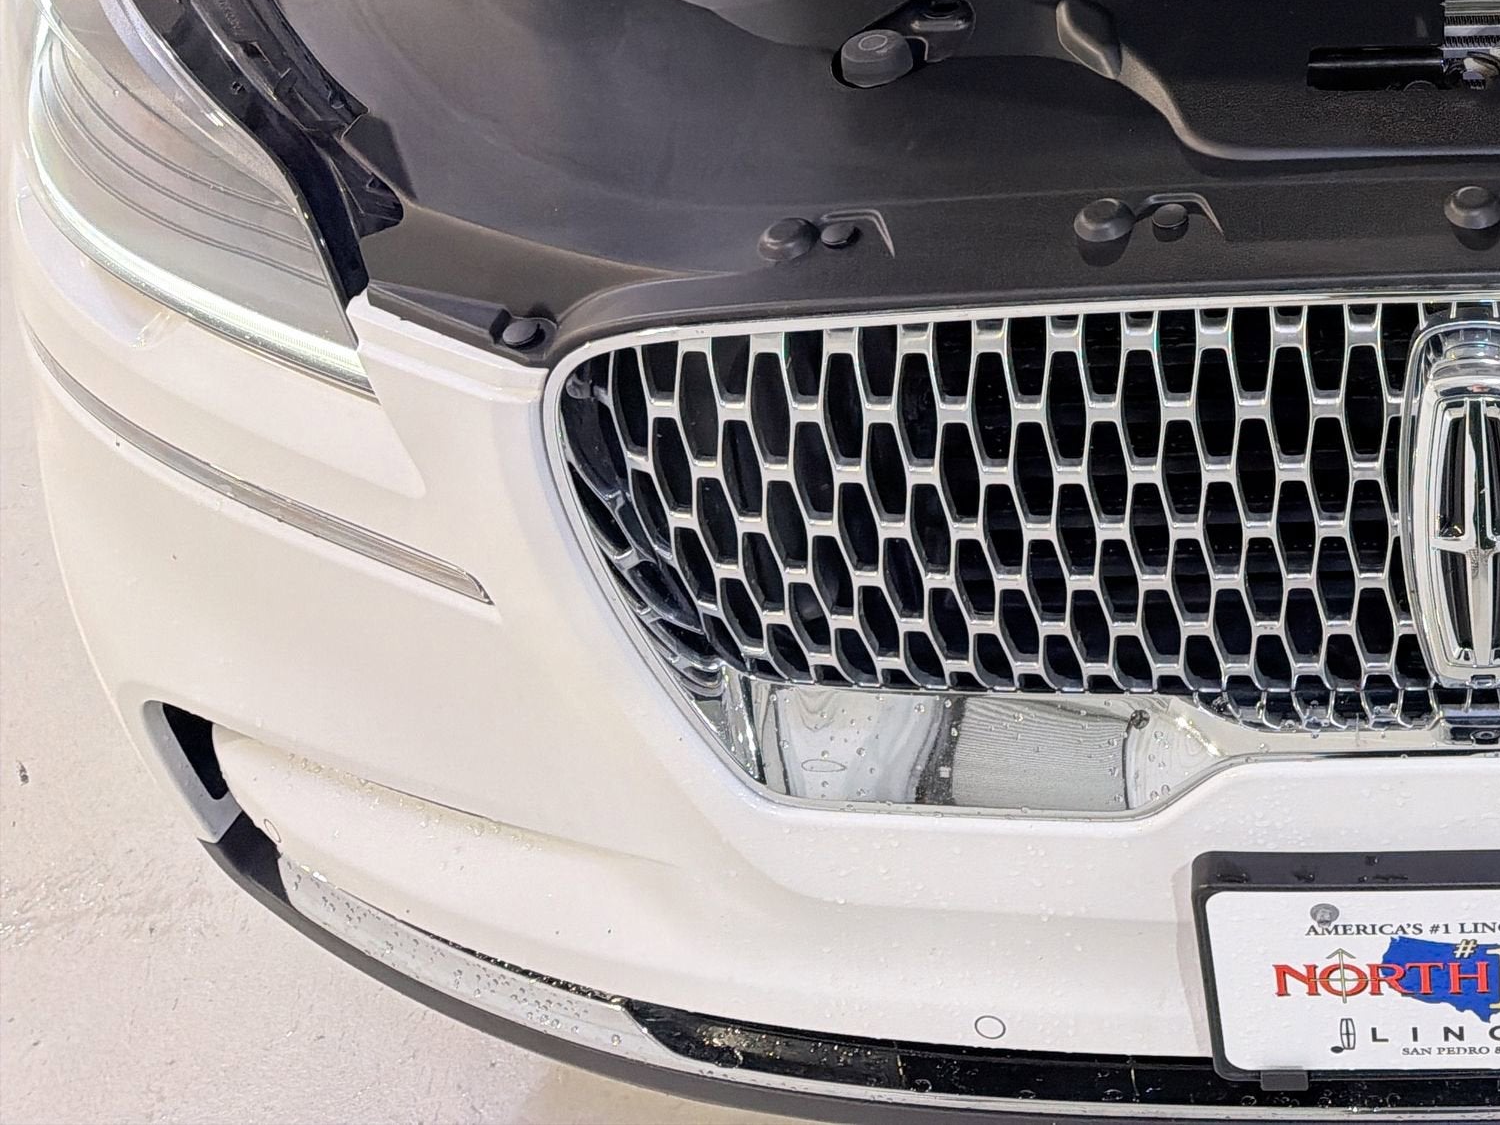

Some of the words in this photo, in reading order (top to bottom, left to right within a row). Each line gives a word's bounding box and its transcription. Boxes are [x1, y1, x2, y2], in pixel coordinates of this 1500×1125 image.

[1305, 923, 1424, 936] AMERICA'S
[1429, 923, 1452, 935] #1
[1272, 961, 1491, 997] NORTH
[1402, 1047, 1434, 1056] SAN
[1436, 1046, 1490, 1055] PEDRO
